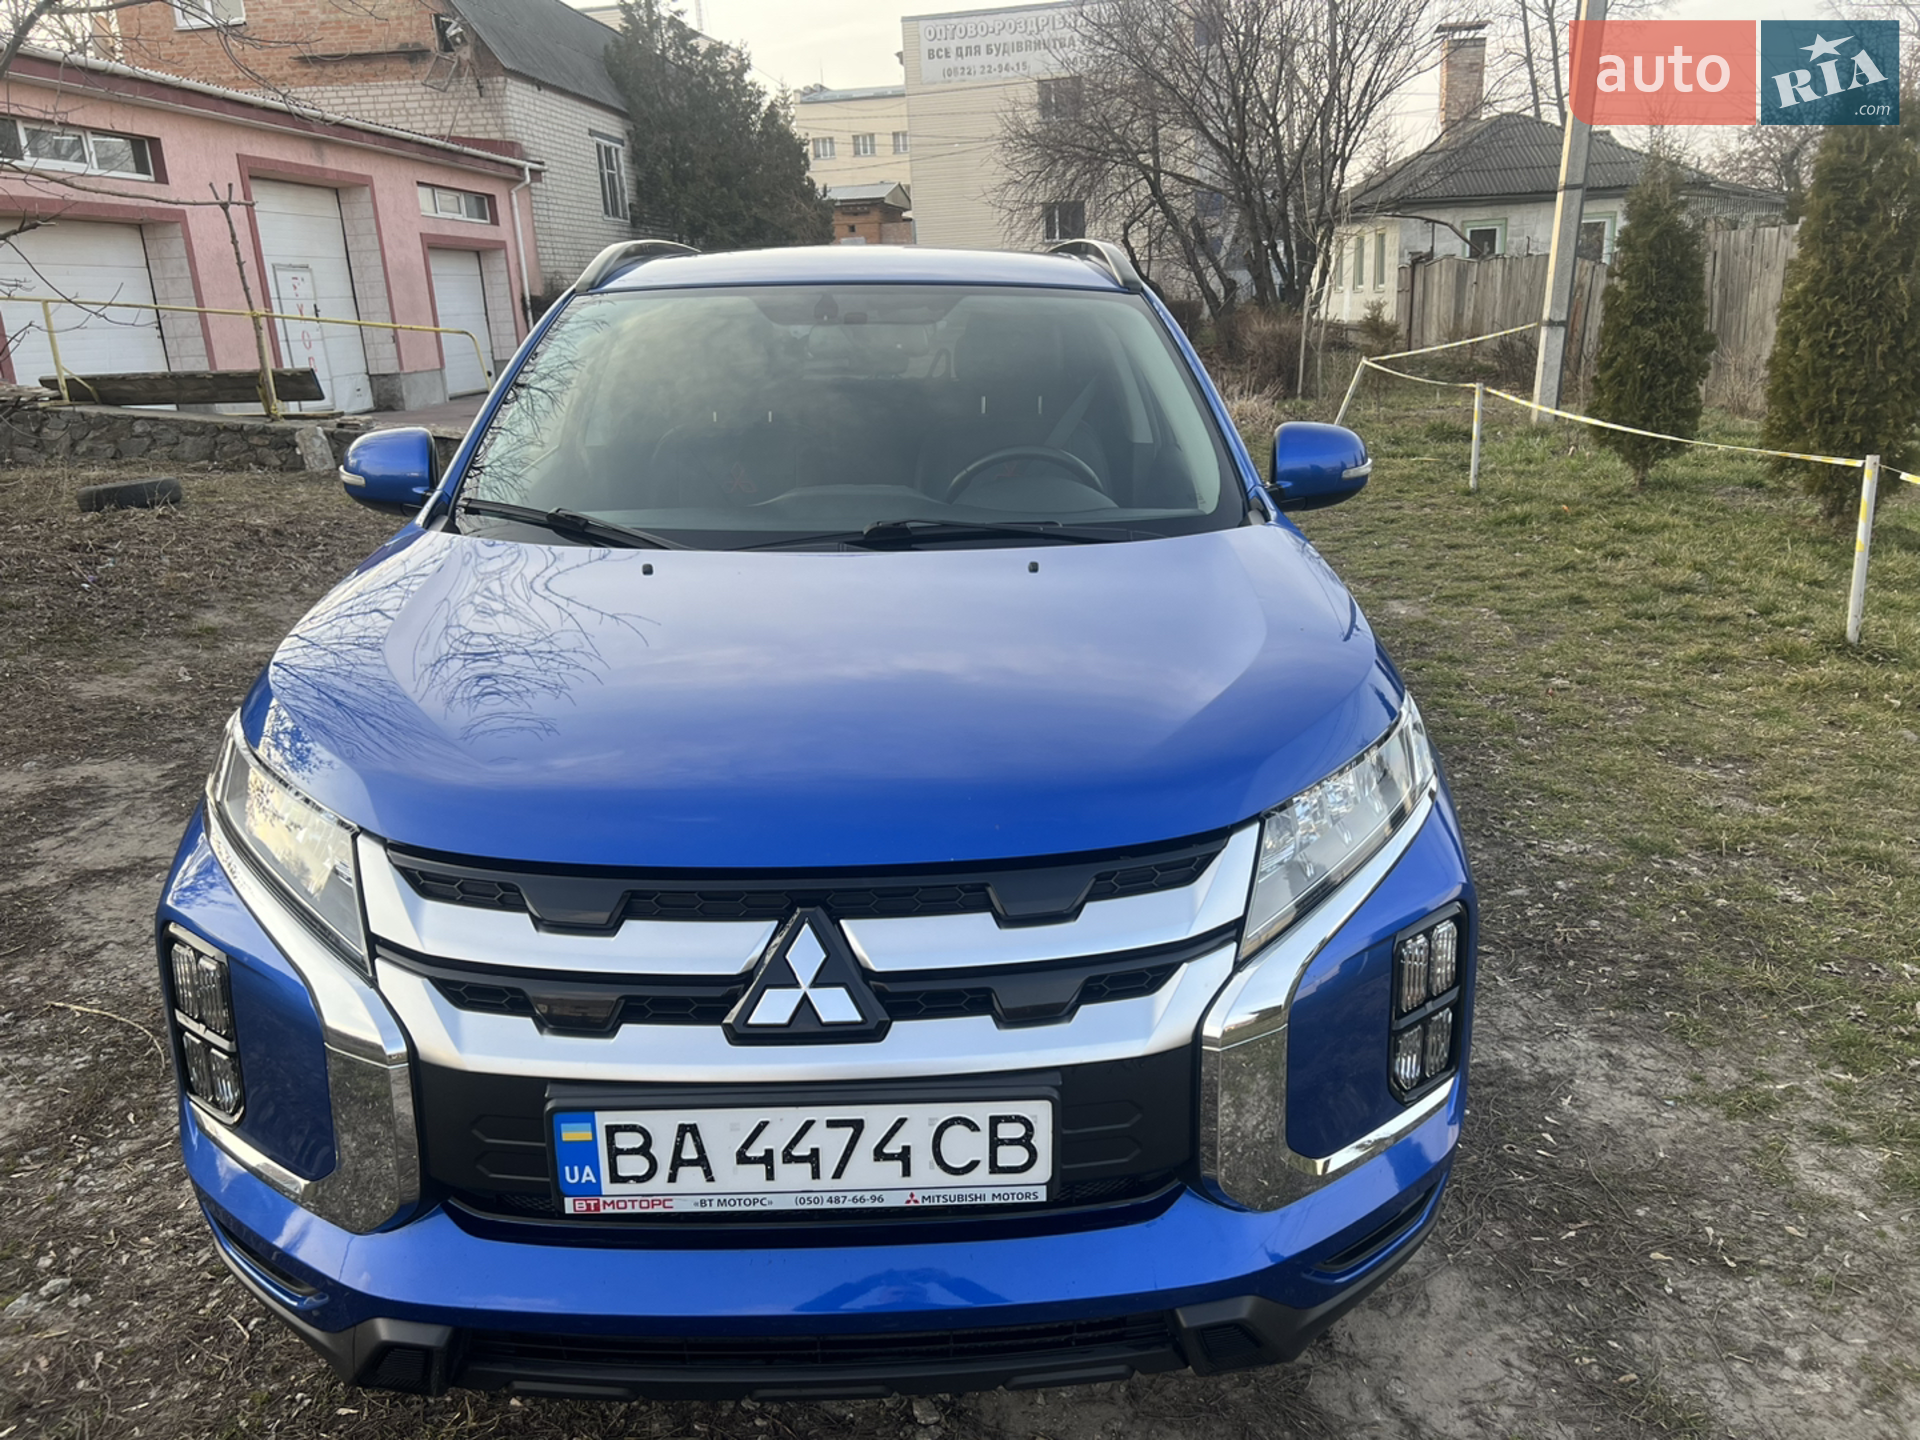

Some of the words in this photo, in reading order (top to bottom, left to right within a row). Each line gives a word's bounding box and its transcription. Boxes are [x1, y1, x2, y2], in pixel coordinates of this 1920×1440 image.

[927, 48, 951, 60] ВСЕ
[955, 44, 981, 60] ДЛЯ
[604, 1121, 717, 1185] BA
[735, 1116, 912, 1182] 4474
[931, 1114, 1039, 1177] CB
[564, 1165, 597, 1184] UA
[794, 1195, 824, 1206] (050)
[826, 1194, 885, 1205] 487-66-96
[921, 1193, 986, 1204] MITSUBISHI
[991, 1191, 1039, 1202] MOTORS
